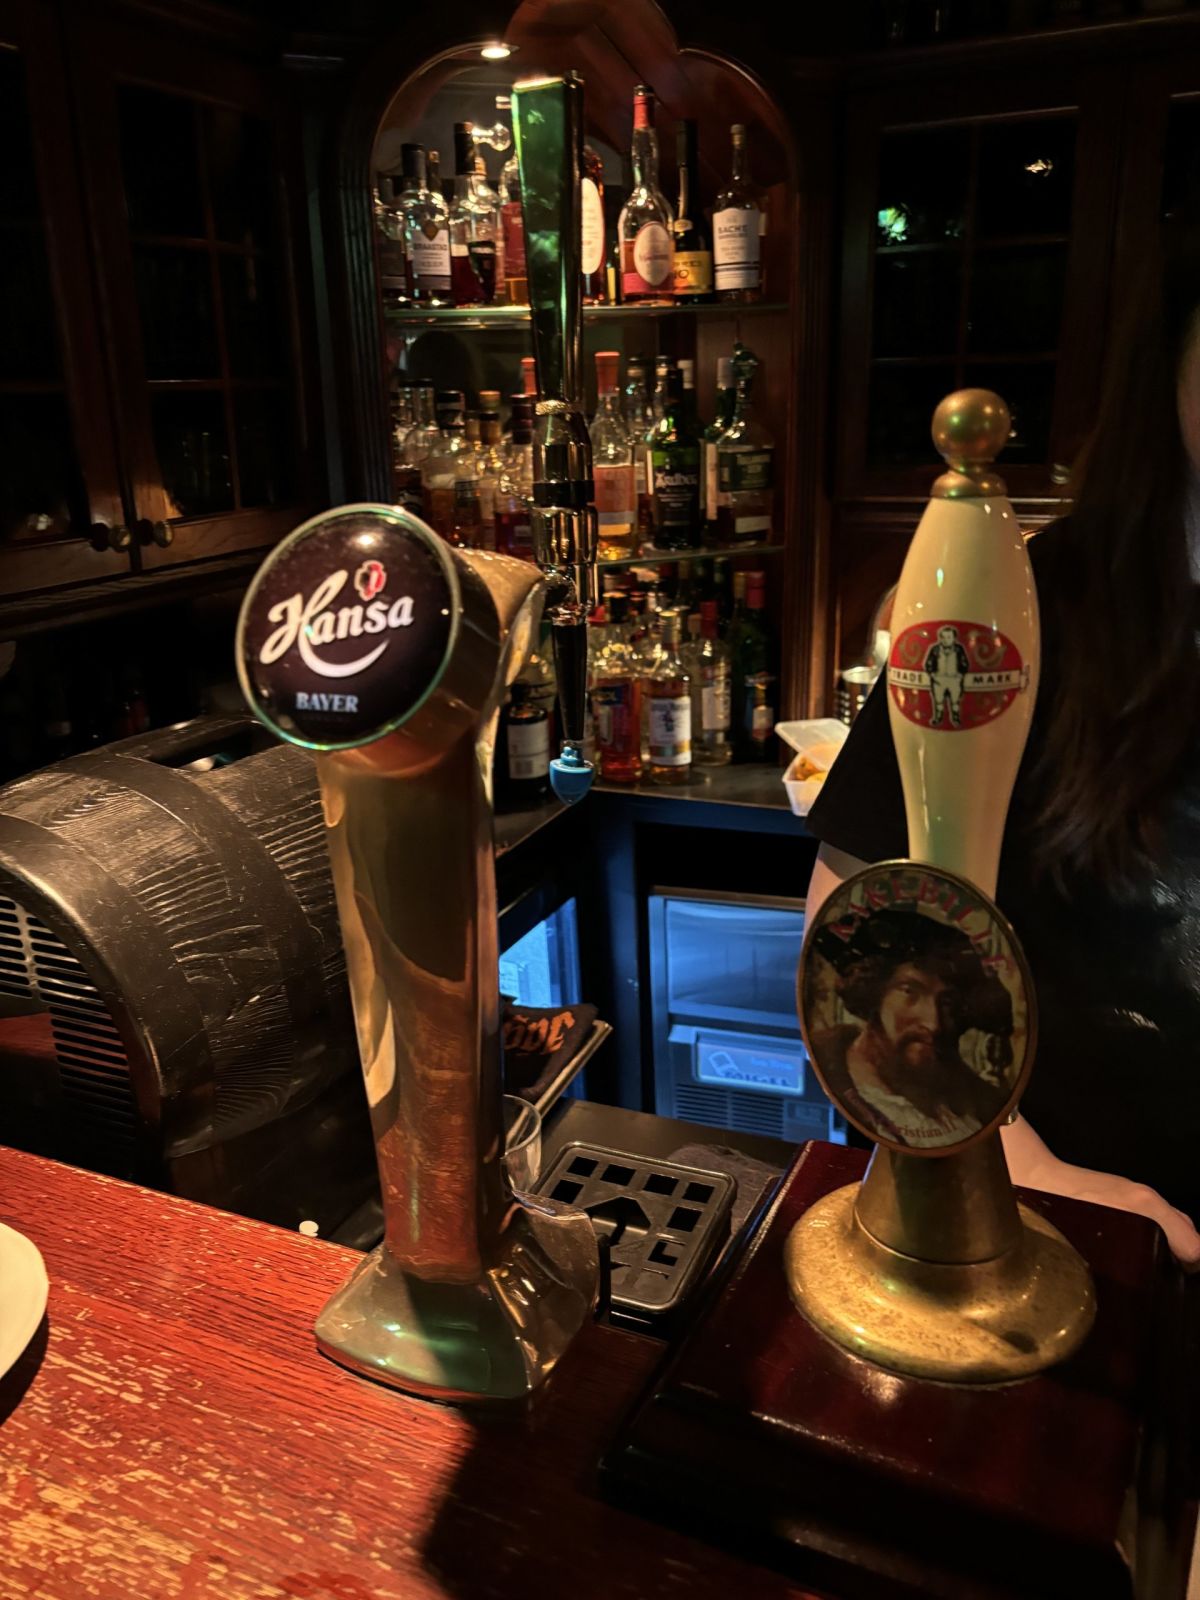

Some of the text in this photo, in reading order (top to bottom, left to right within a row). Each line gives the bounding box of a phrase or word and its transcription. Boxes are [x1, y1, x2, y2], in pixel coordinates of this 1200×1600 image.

[259, 569, 415, 678] Hansa
[892, 669, 1012, 684] TRADE MARK
[295, 692, 360, 713] BAYER
